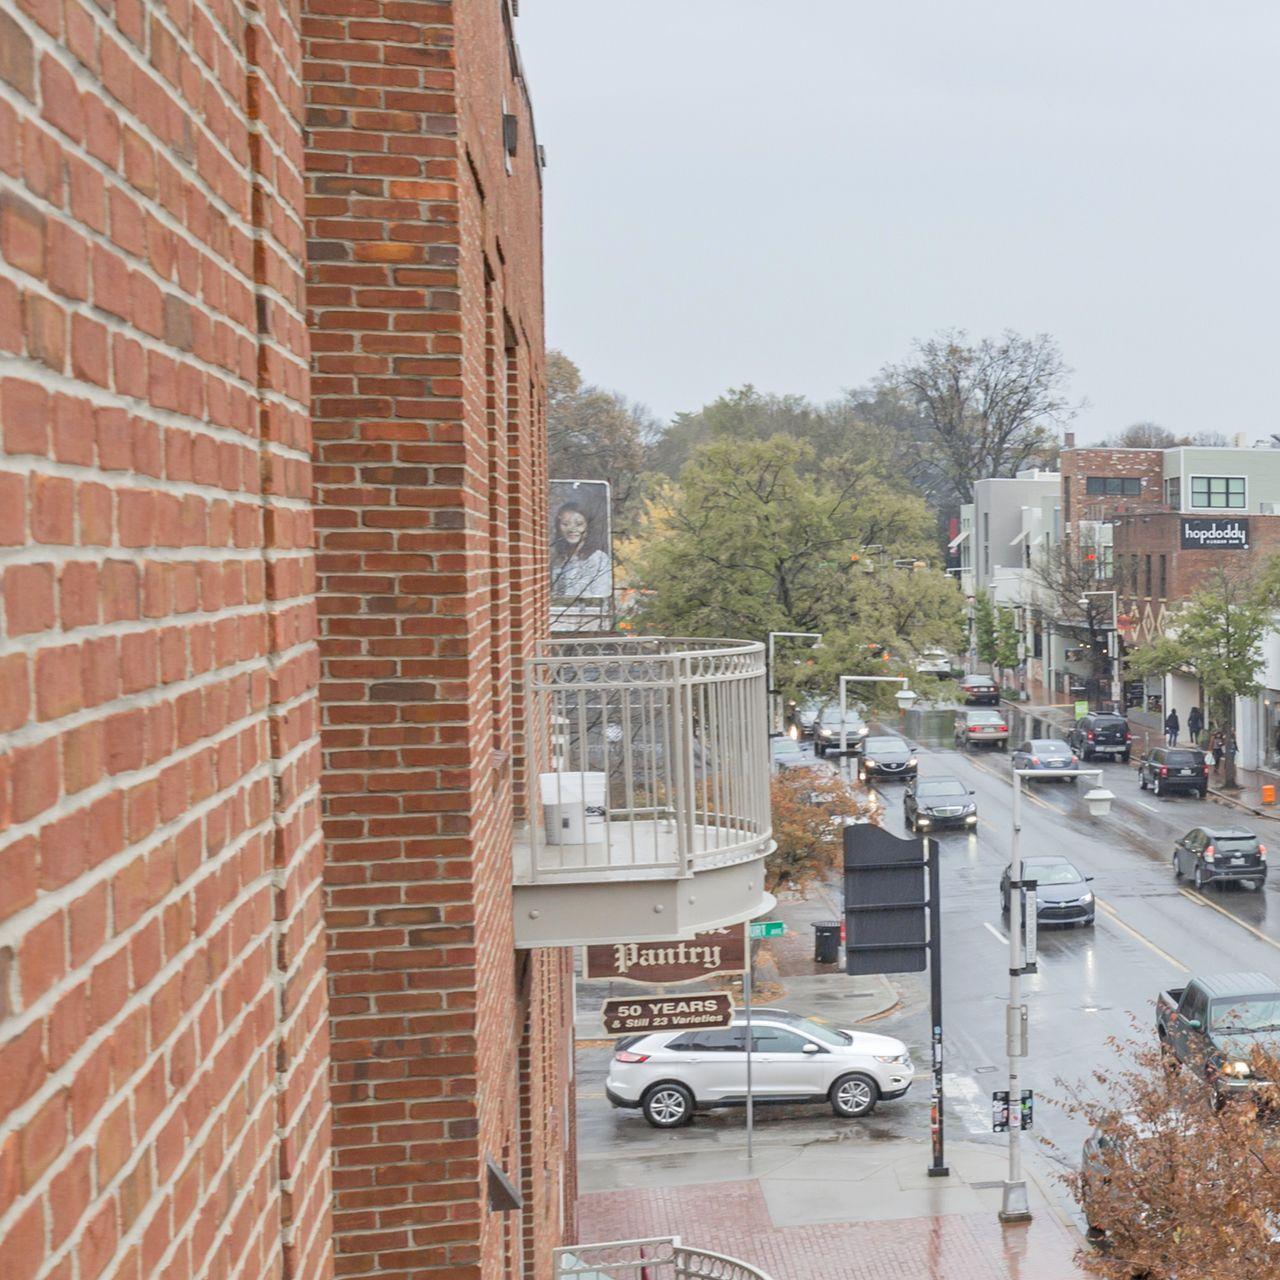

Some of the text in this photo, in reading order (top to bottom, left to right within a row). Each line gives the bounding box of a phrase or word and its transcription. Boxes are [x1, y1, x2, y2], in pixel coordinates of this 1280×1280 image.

[1184, 523, 1246, 544] hopdoddy
[614, 942, 721, 973] Pantry
[618, 1000, 718, 1016] 50 YEARS
[611, 1014, 724, 1028] & Still 23 Varieties
